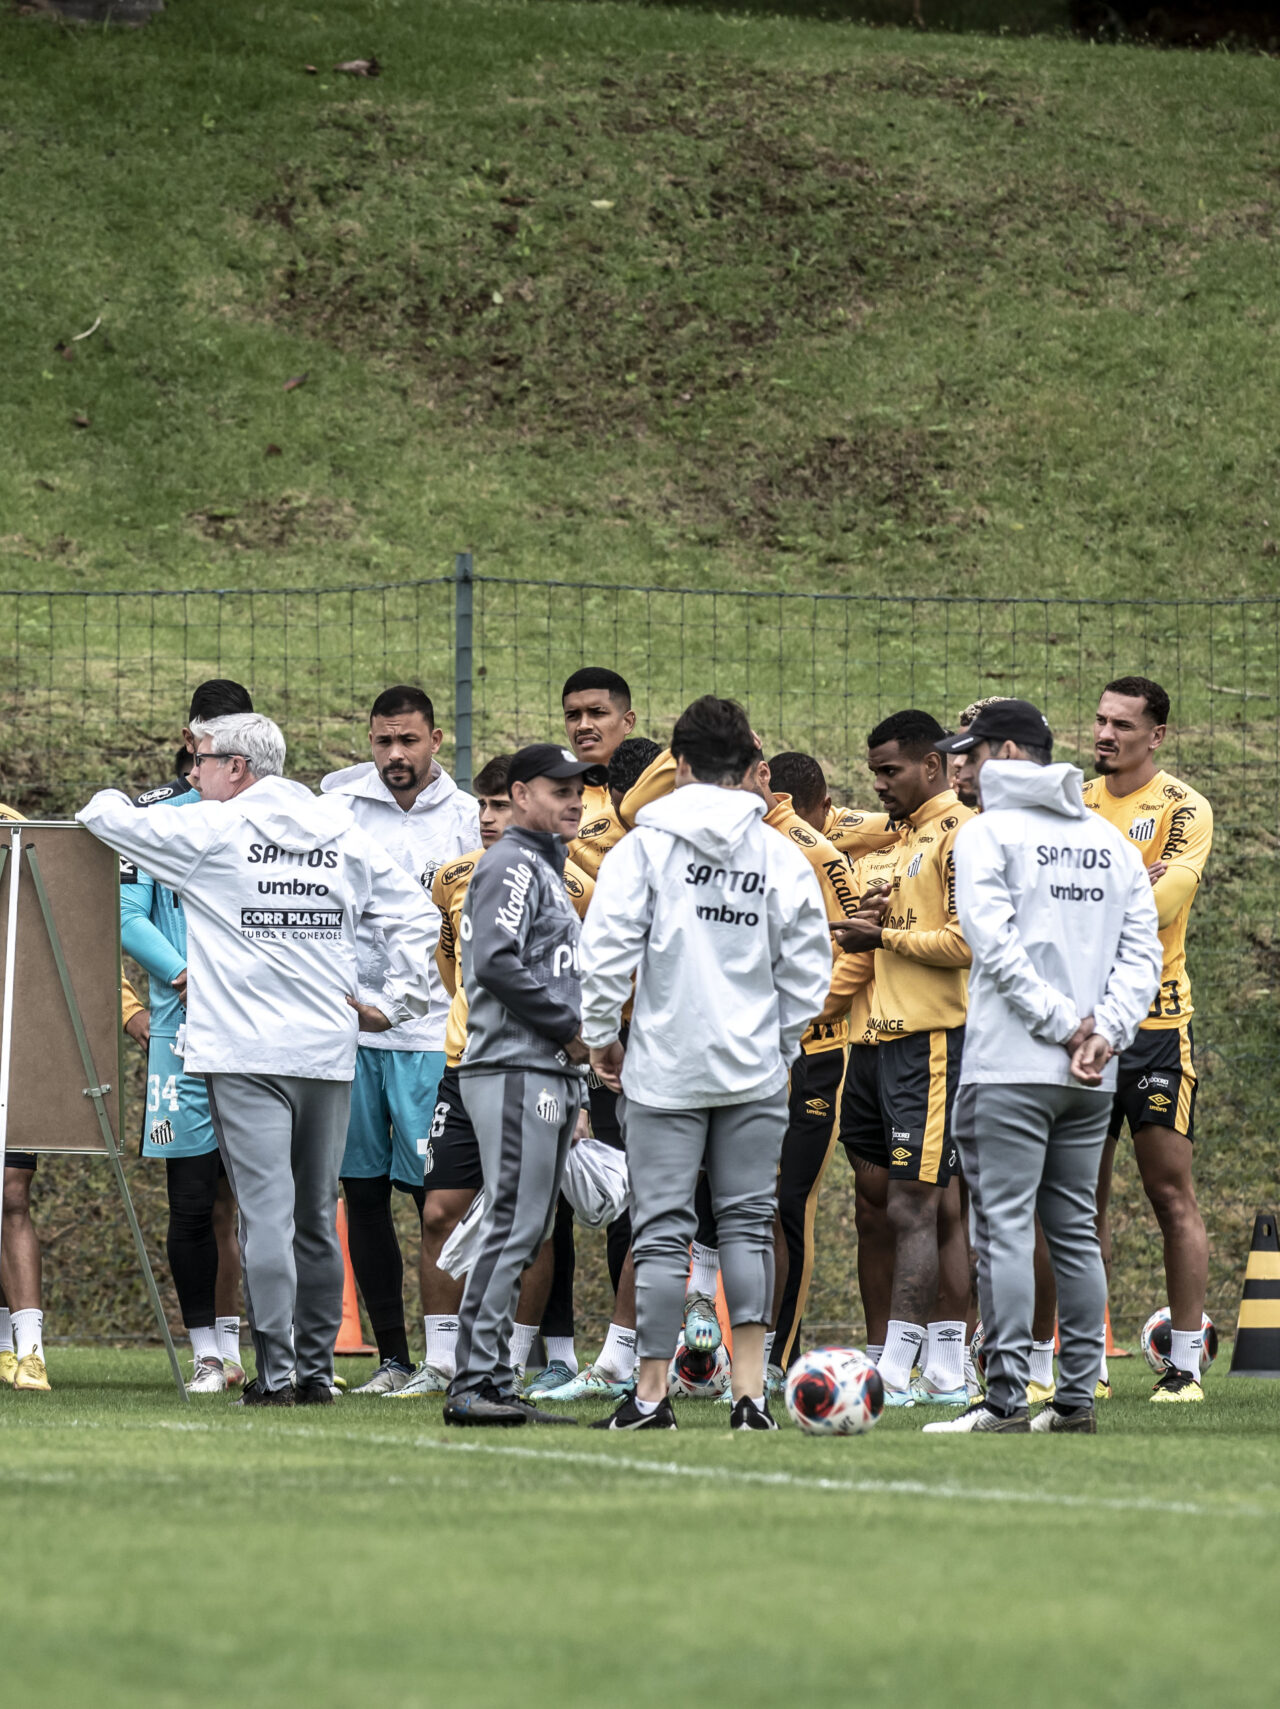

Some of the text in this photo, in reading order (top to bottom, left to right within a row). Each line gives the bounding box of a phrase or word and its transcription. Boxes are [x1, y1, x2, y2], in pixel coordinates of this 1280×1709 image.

[1160, 806, 1197, 861] Kicaldo
[1036, 845, 1112, 869] SANTOS
[257, 878, 329, 897] umbro
[1050, 883, 1105, 902] umbro
[495, 863, 533, 935] Kicaldo
[242, 911, 342, 926] CORR PLASTIK
[242, 930, 342, 940] TUBOS E CONEXÕES
[148, 1074, 180, 1112] 34
